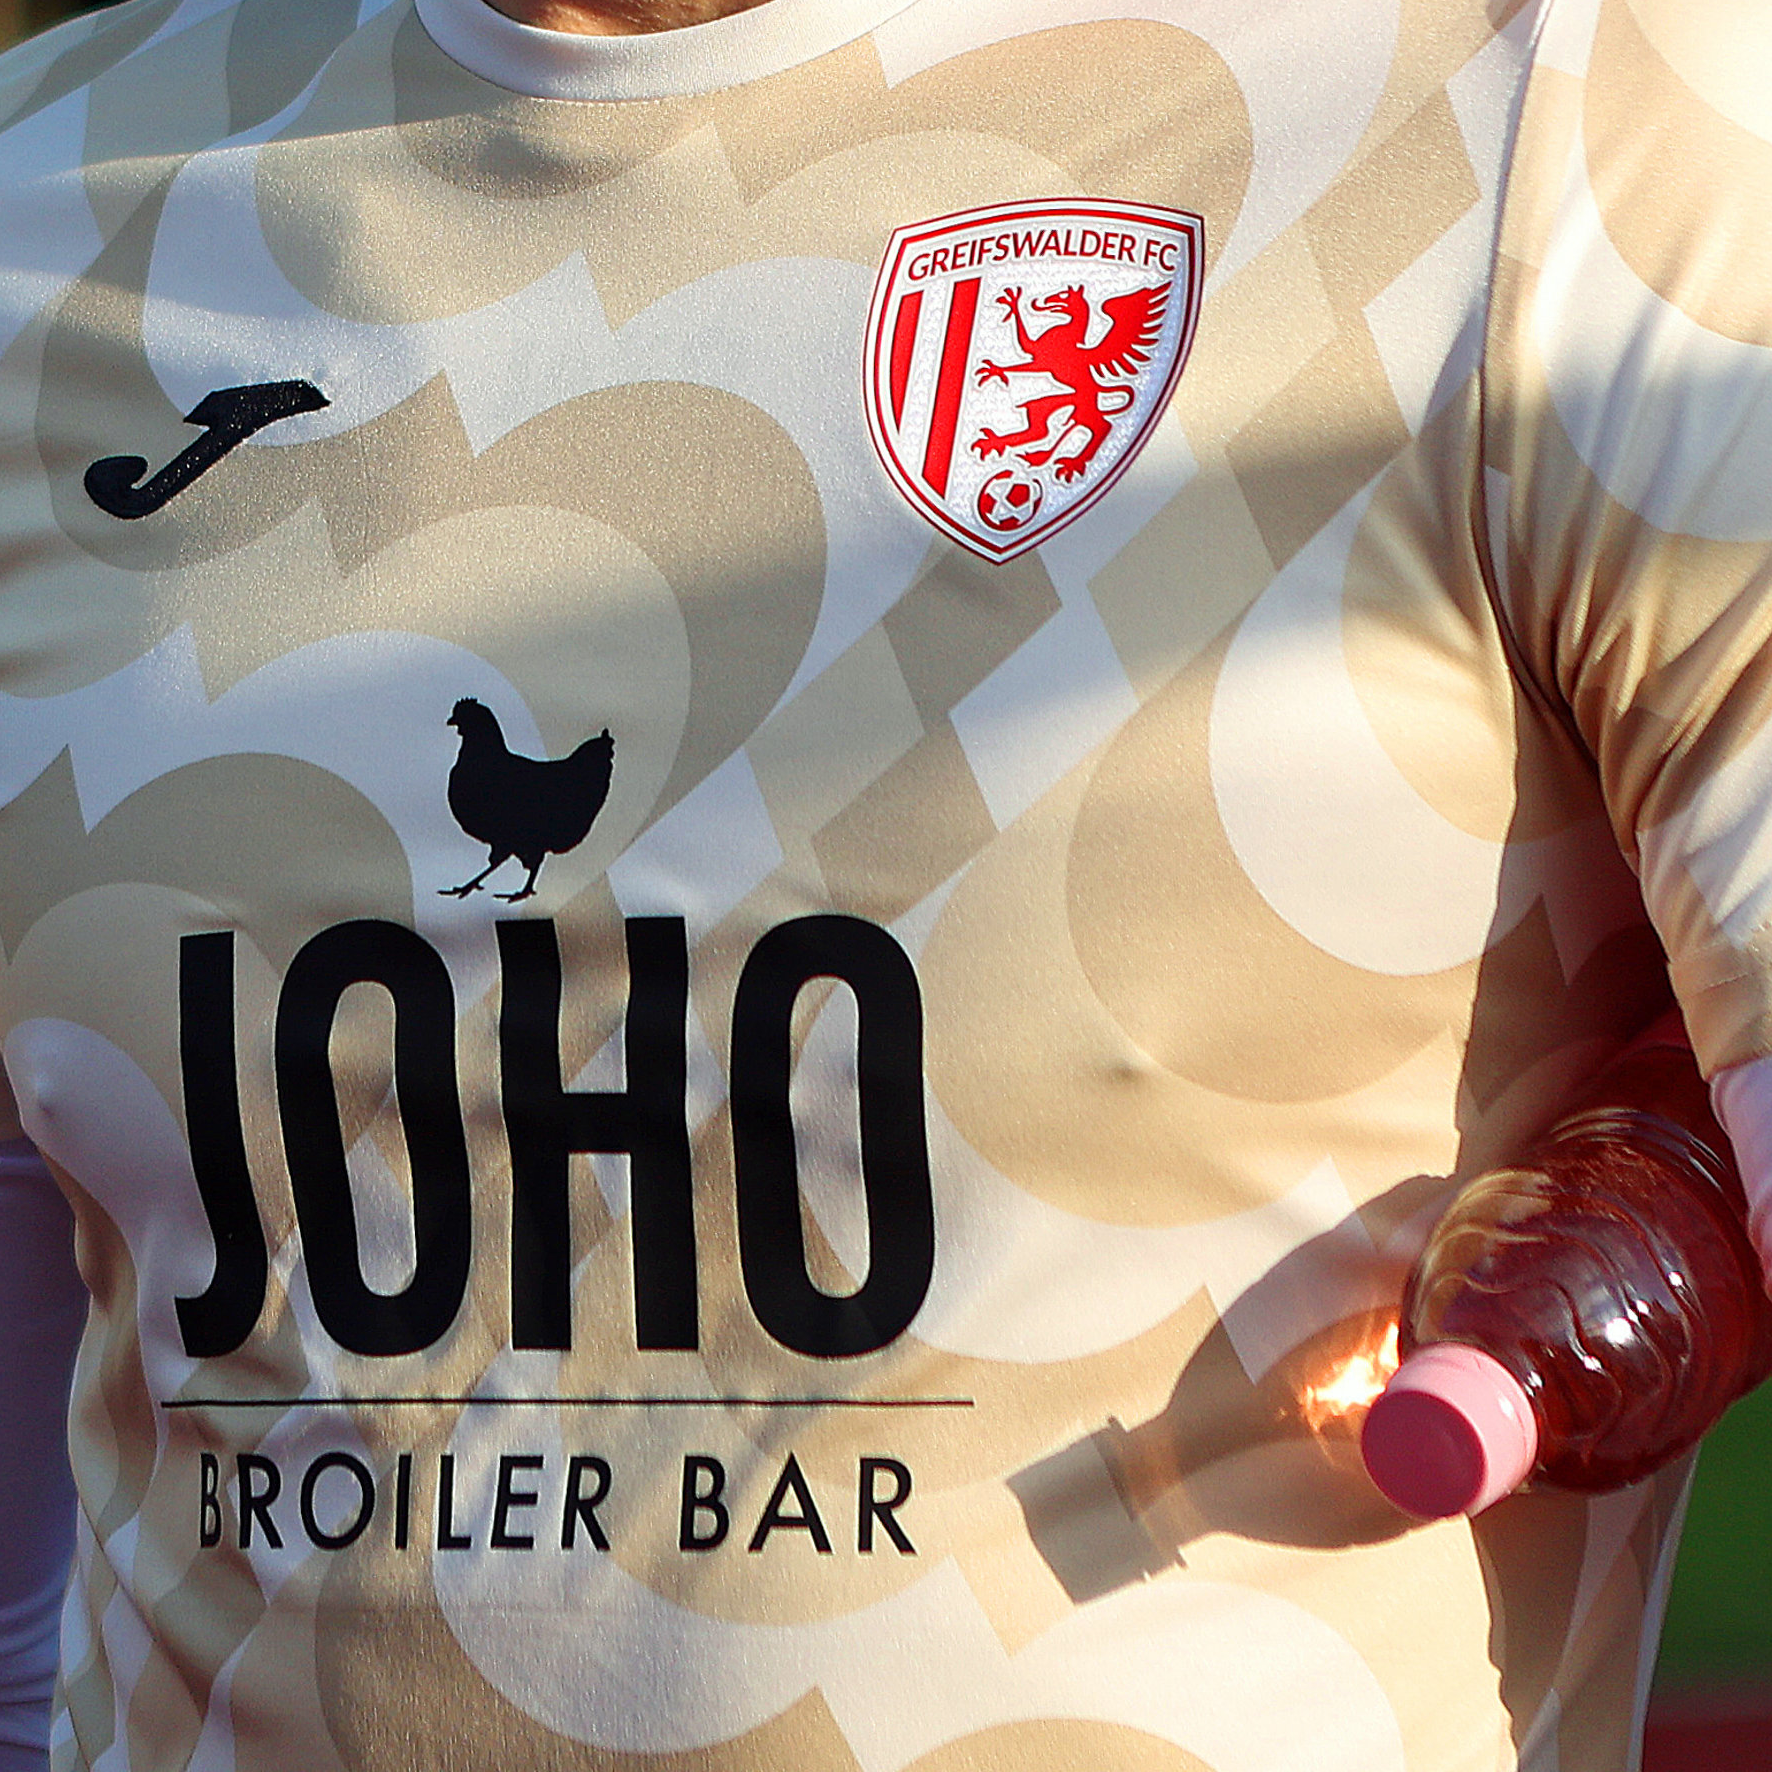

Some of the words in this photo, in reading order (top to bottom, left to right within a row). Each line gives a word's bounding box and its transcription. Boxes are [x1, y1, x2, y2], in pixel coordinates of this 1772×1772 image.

[908, 229, 1137, 282] GREIFSWALDER
[1142, 239, 1178, 271] FC
[174, 914, 935, 1359] JOHO
[199, 1453, 611, 1551] BROILER
[679, 1453, 918, 1554] BAR
